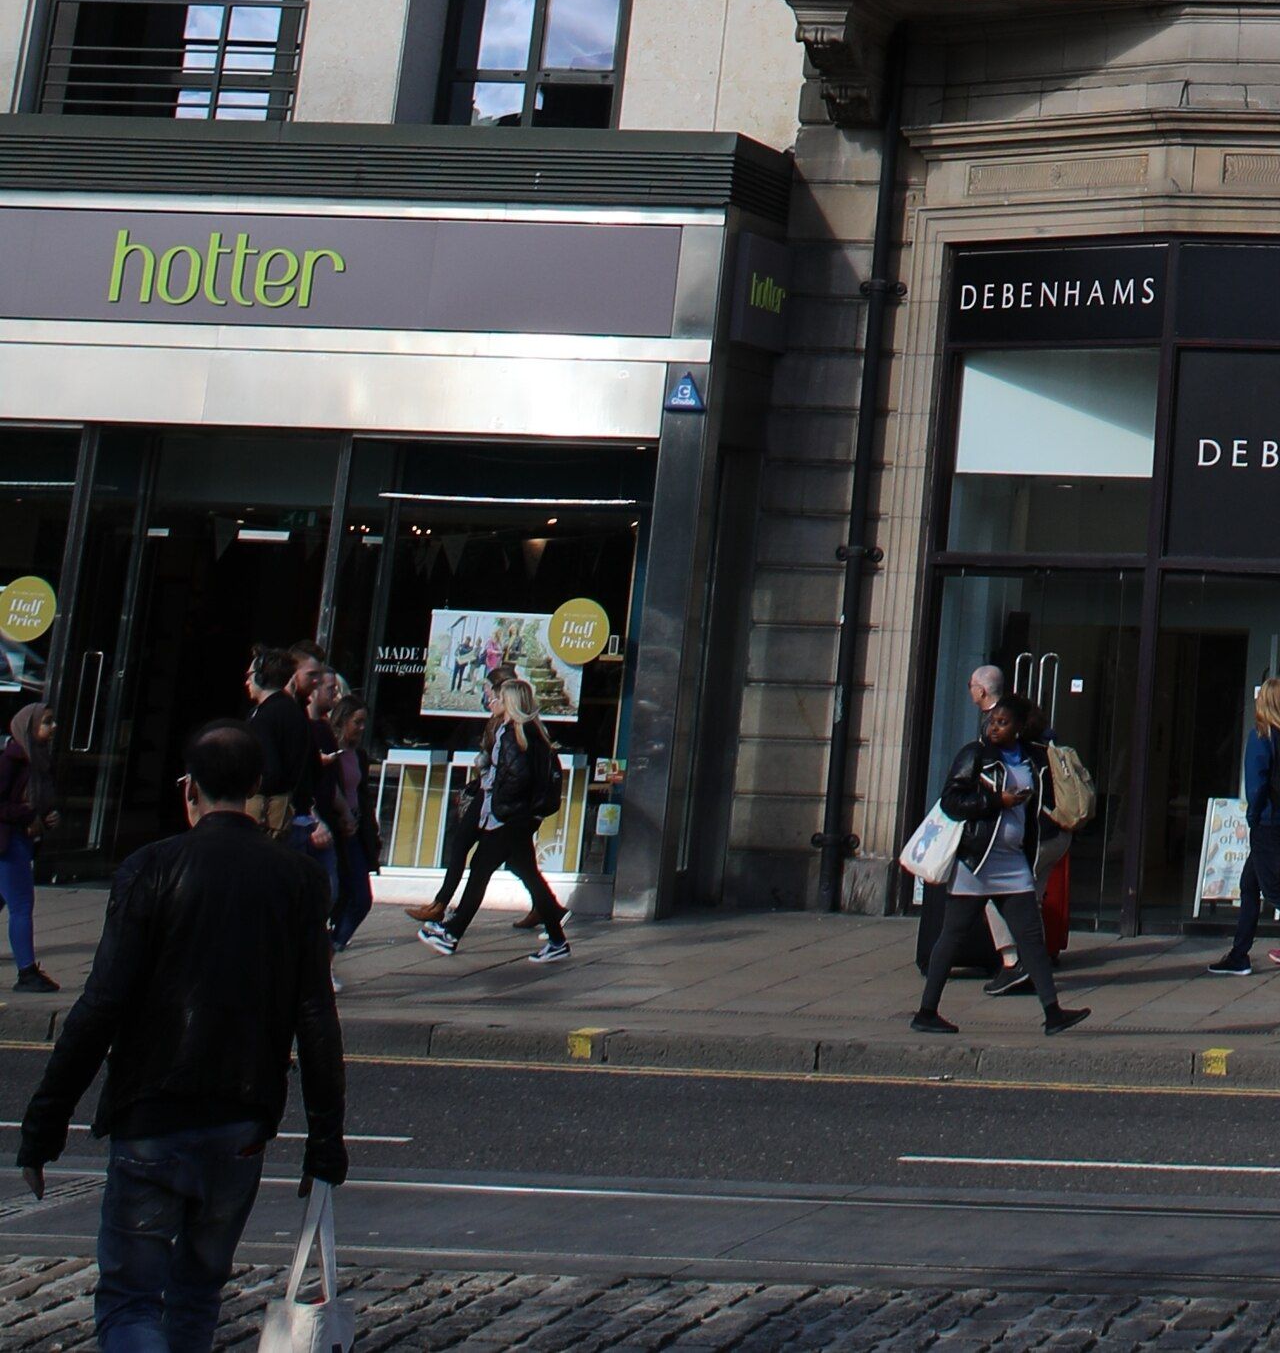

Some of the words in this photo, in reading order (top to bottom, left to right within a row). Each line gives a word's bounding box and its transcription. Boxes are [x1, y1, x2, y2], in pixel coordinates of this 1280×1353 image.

[108, 229, 346, 308] hotter
[960, 277, 1155, 310] DEBENHAMS
[10, 598, 45, 616] Half
[7, 613, 41, 628] Price
[562, 620, 598, 638] Half
[560, 635, 595, 649] Price
[376, 646, 420, 660] MADE
